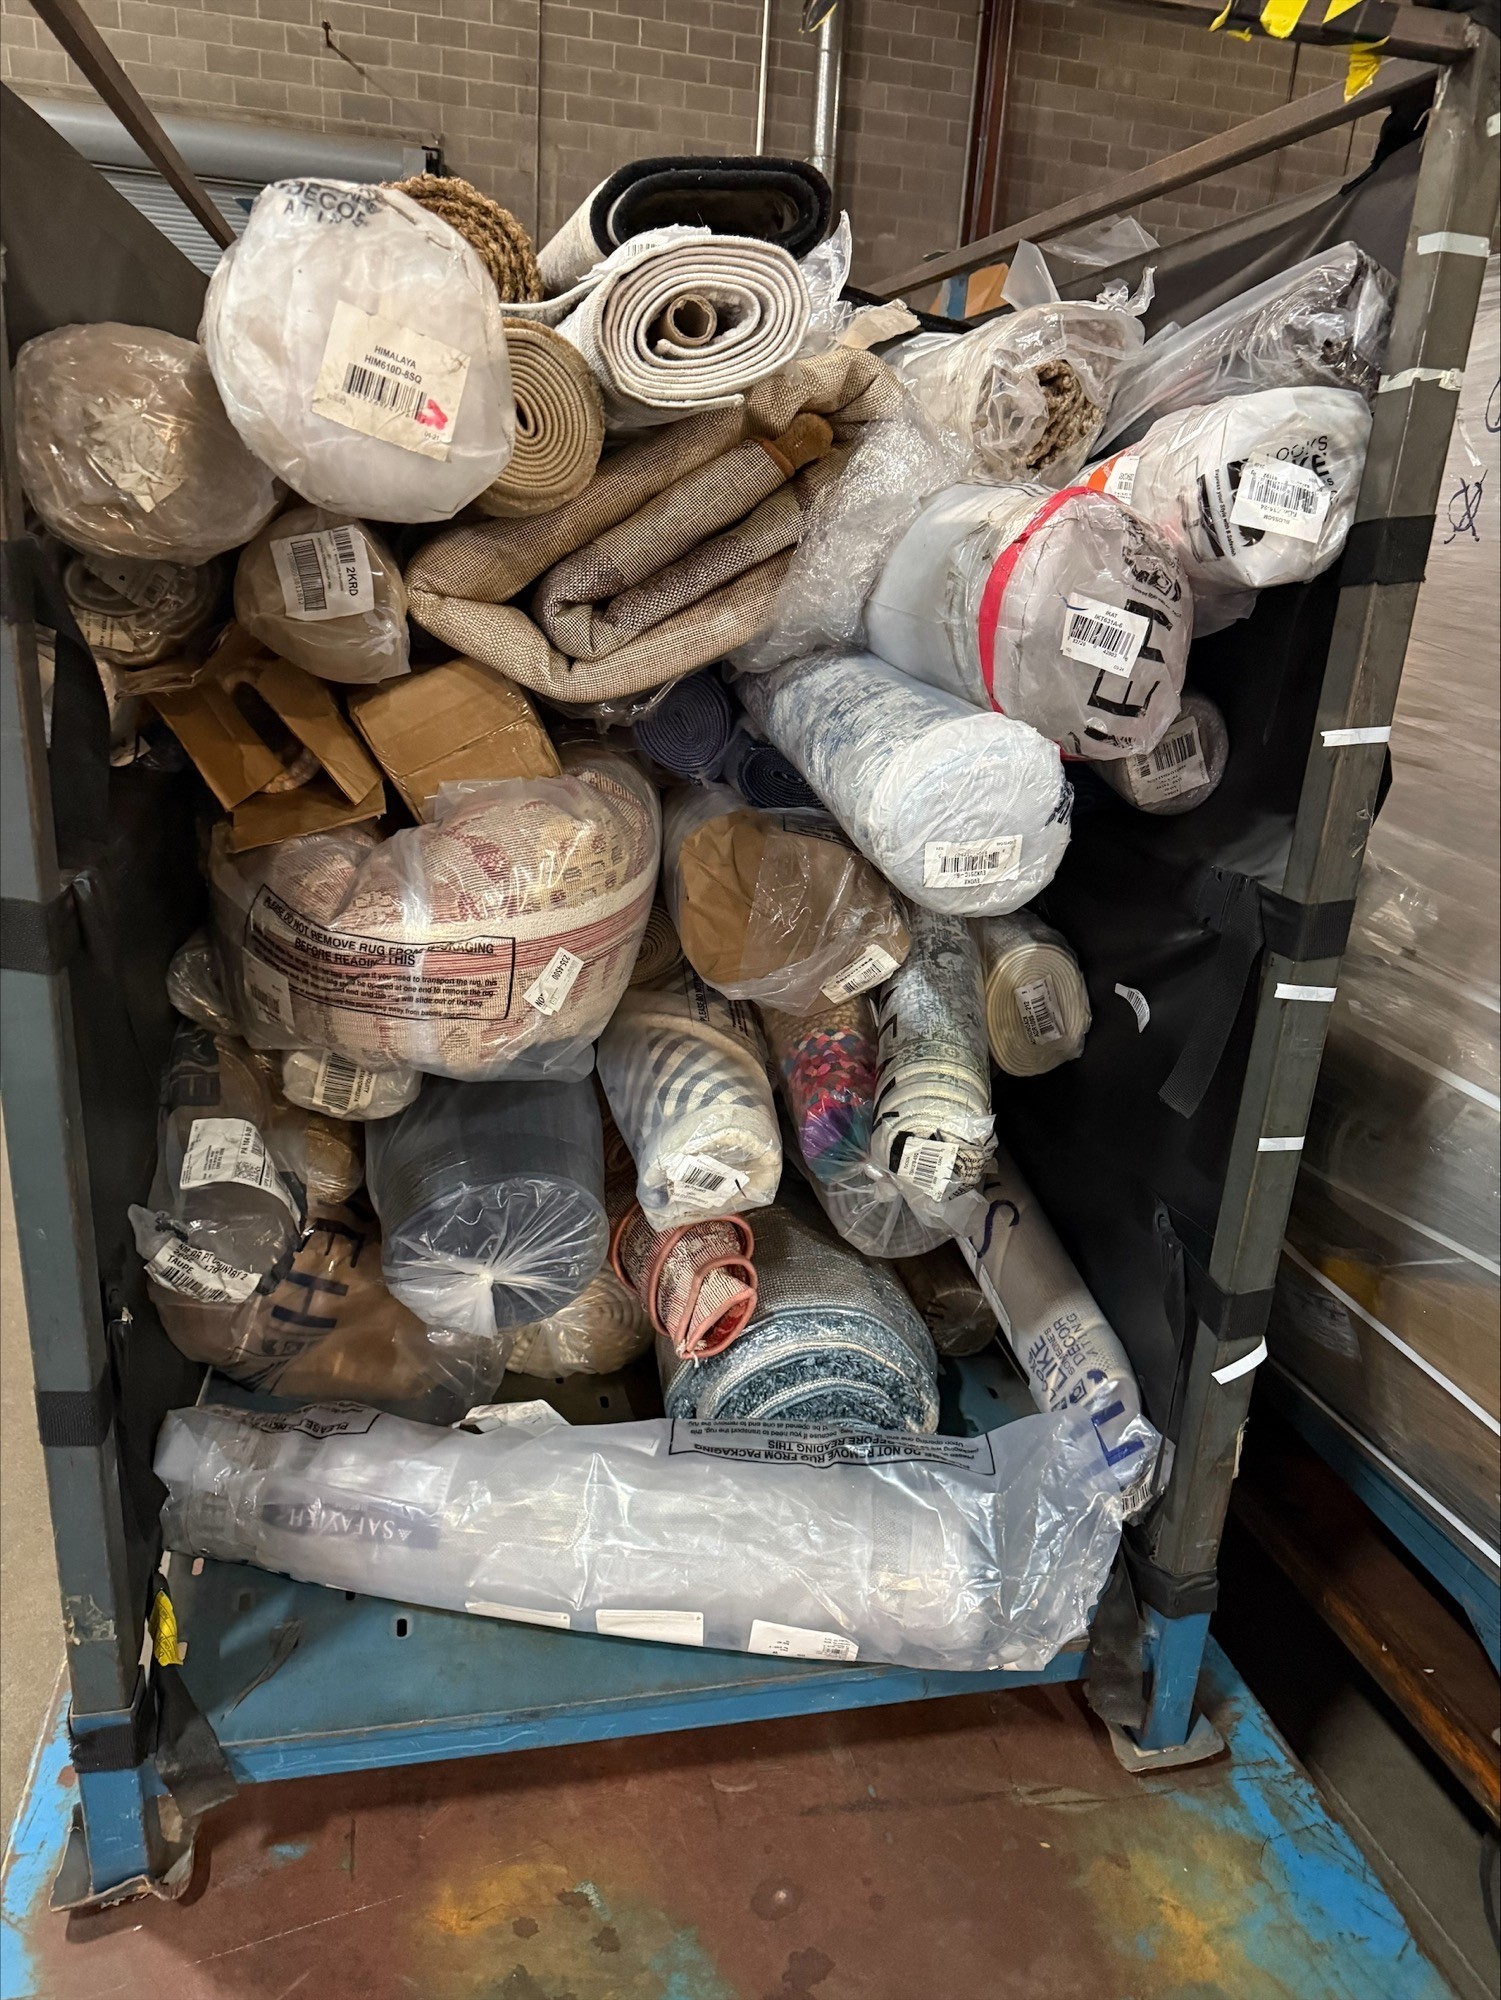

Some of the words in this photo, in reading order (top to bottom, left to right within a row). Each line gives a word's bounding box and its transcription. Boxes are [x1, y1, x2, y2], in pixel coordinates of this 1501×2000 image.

[374, 345, 416, 369] HIMALAYA
[364, 354, 422, 384] HIM610D-8SQ
[1266, 435, 1328, 461] OOKS
[1263, 514, 1290, 525] BLOSSOM
[346, 566, 359, 596] 2KRD
[1105, 610, 1118, 619] IKAT
[263, 896, 283, 919] PLEASE
[283, 914, 293, 927] DO
[293, 918, 308, 937] NOT
[311, 930, 356, 951] REMOVE
[358, 942, 385, 956] RUG
[294, 938, 332, 964] BEFORE
[388, 953, 416, 967] THIS
[552, 954, 571, 980] 235-4500
[413, 976, 420, 984] to
[485, 979, 498, 987] this
[418, 985, 432, 994] end
[433, 986, 441, 995] to
[535, 993, 545, 1007] ON
[167, 1255, 194, 1275] TAUPE
[1053, 1315, 1086, 1367] DECOR
[1028, 1334, 1068, 1394] LIKE
[306, 1418, 349, 1432] PLEASE
[693, 1443, 761, 1458] PACKAGING
[767, 1440, 792, 1450] THIS
[796, 1437, 845, 1452] READING
[877, 1442, 901, 1459] NOT
[903, 1446, 921, 1456] DO
[764, 1450, 796, 1460] FROM
[800, 1454, 824, 1463] RUG
